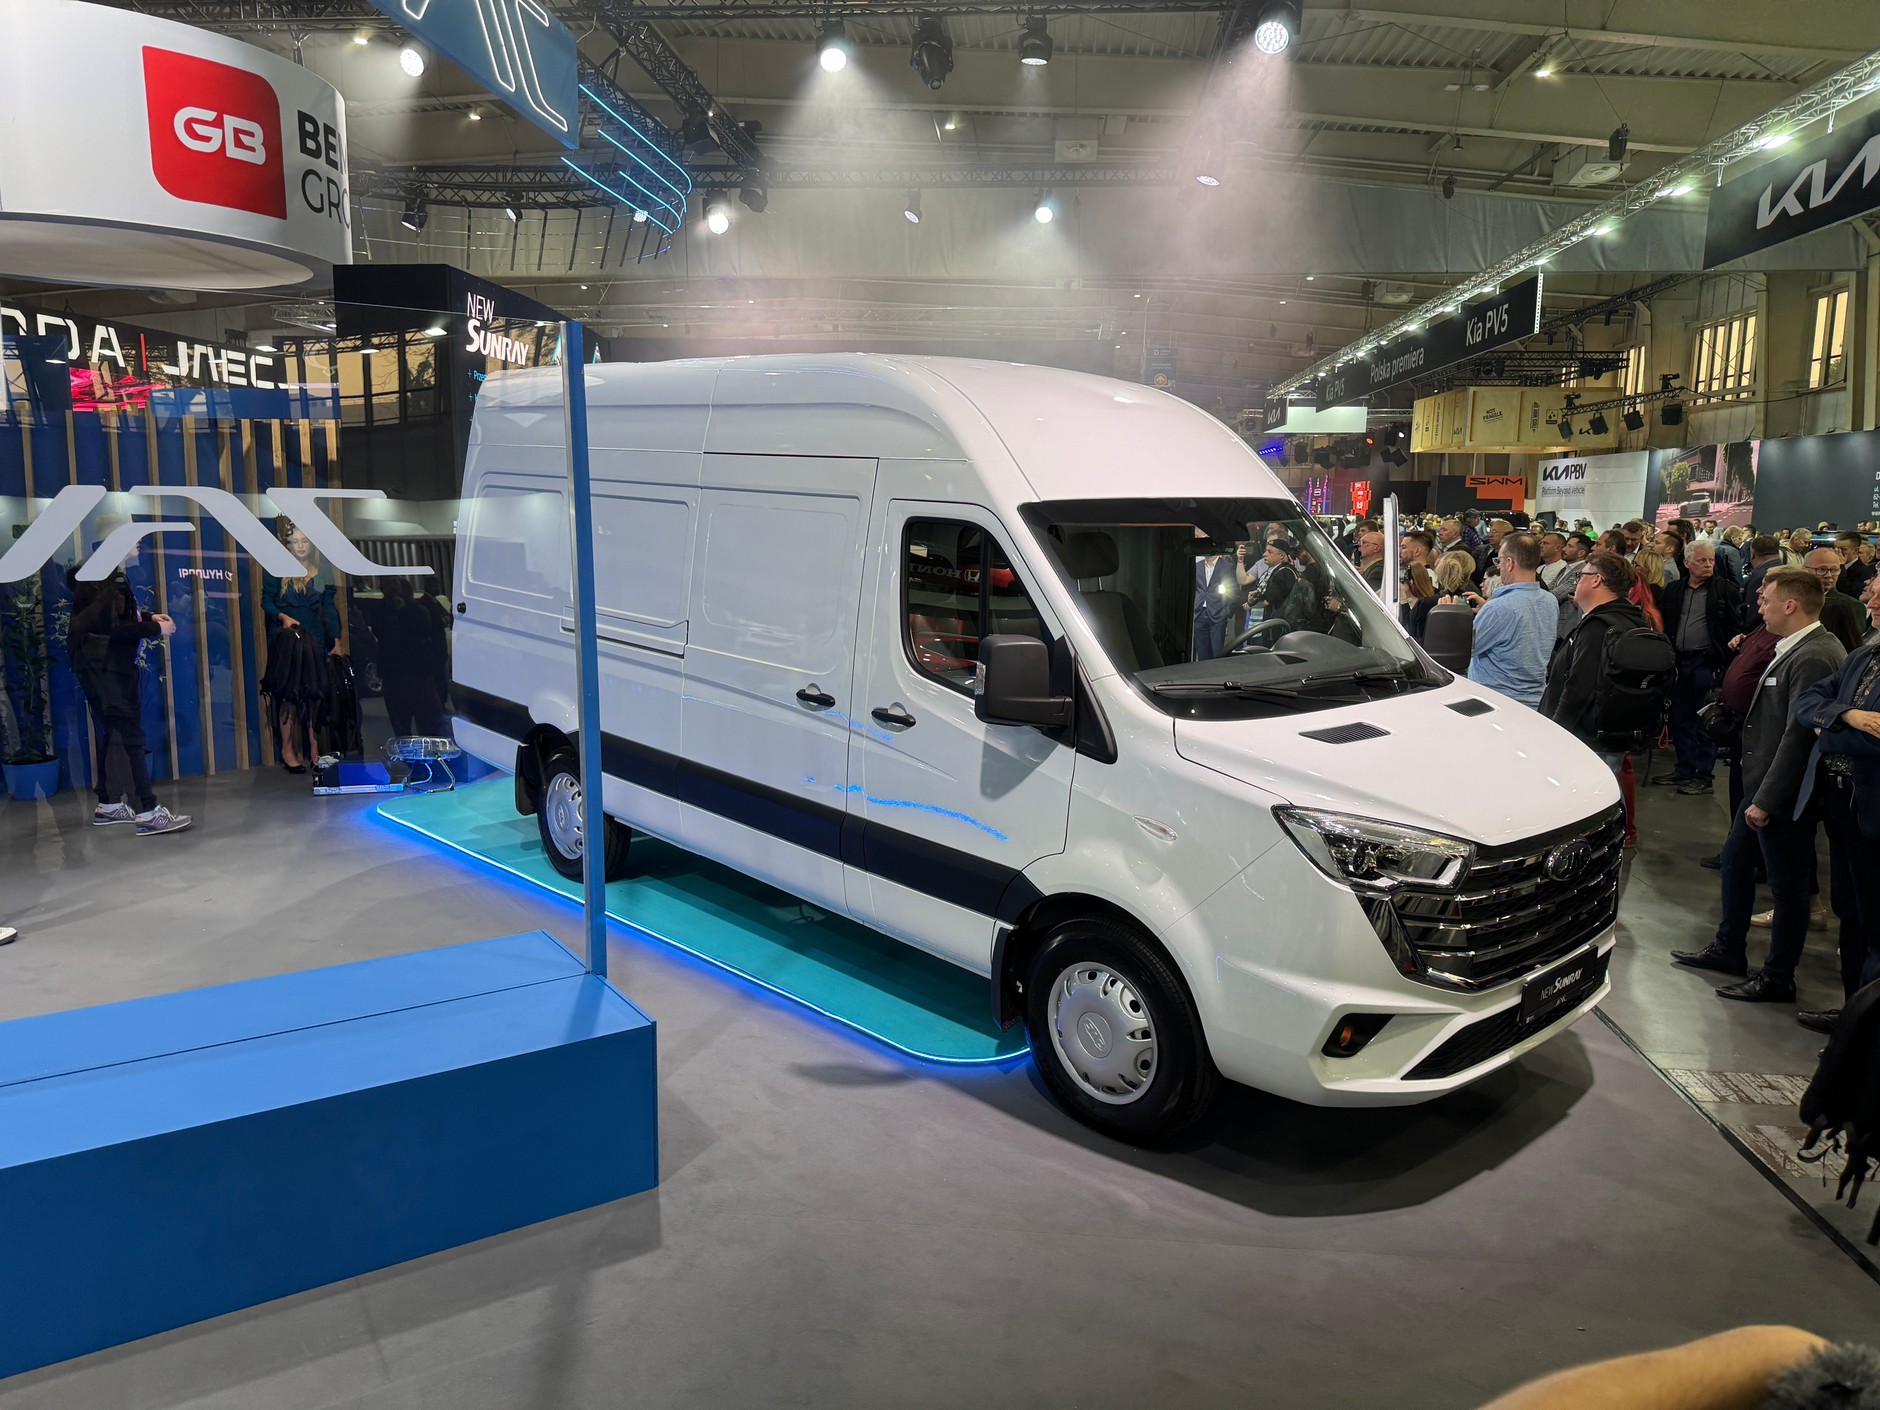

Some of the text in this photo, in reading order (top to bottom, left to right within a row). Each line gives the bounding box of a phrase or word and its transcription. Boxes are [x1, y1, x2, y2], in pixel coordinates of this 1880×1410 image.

[173, 105, 267, 166] GB
[467, 291, 495, 323] NEW
[1466, 303, 1509, 347] Kia PV5
[1370, 346, 1424, 384] Polska premiera
[1469, 477, 1523, 486] SWM
[1570, 462, 1587, 480] PBV
[1541, 486, 1557, 496] Platform
[1556, 484, 1571, 497] Beyond
